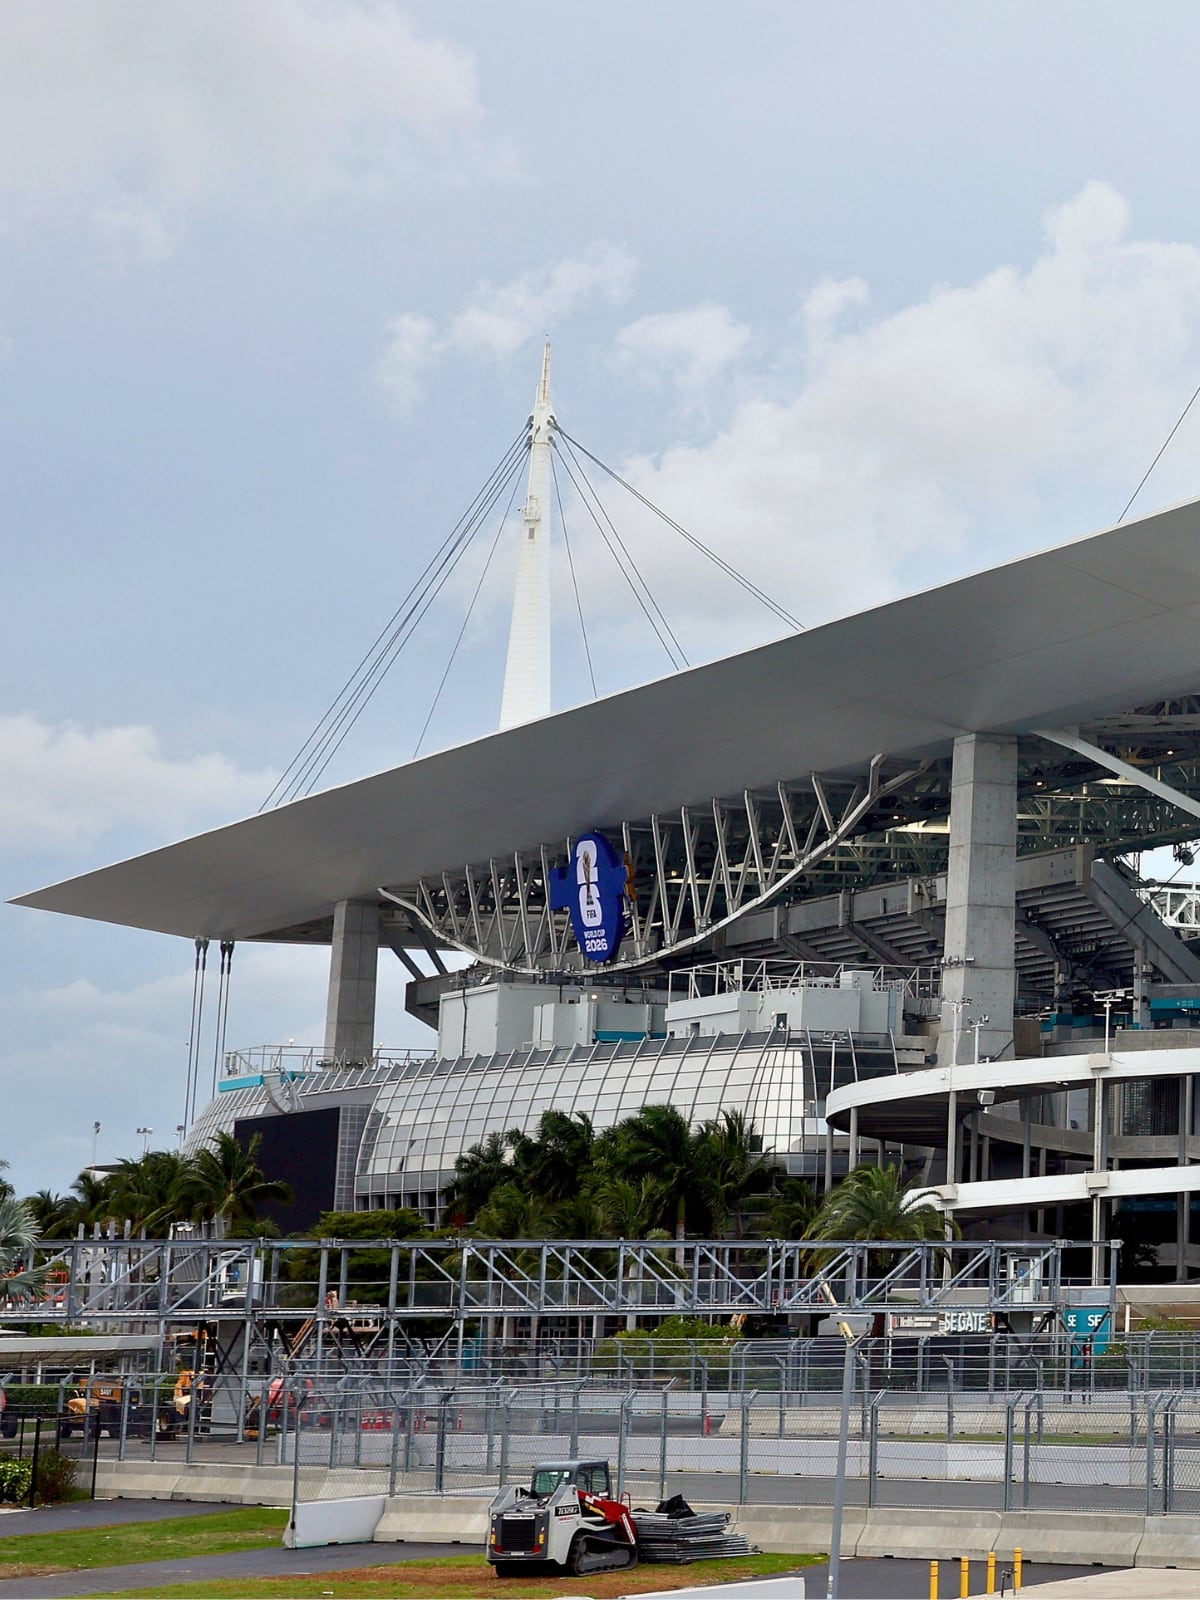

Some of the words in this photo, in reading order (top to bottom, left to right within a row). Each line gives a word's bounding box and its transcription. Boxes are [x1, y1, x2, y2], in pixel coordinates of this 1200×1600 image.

[586, 909, 597, 919] FIFA
[584, 931, 596, 939] WORLD
[596, 929, 606, 938] CUP
[585, 938, 608, 952] 2026
